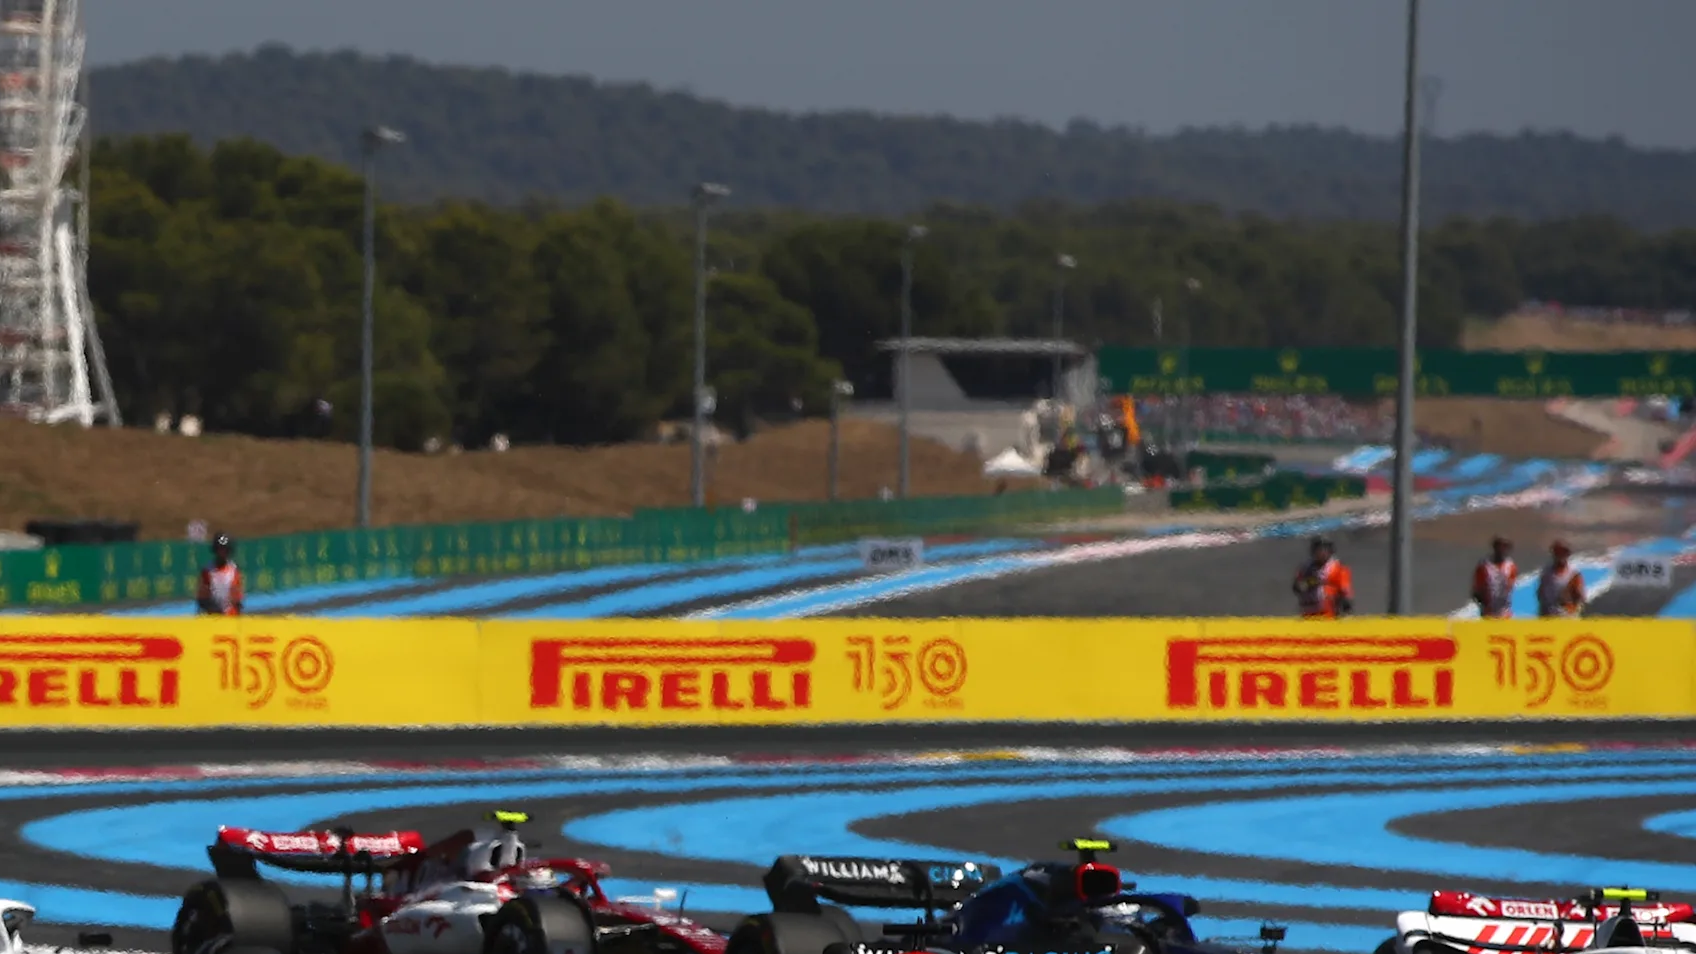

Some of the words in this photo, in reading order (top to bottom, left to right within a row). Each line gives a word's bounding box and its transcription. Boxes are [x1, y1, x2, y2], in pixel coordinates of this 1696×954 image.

[212, 633, 334, 708] 150
[530, 636, 816, 710] PIRELLI
[845, 635, 967, 711] 150
[1166, 635, 1457, 709] PIRELLI
[1488, 634, 1614, 709] 150
